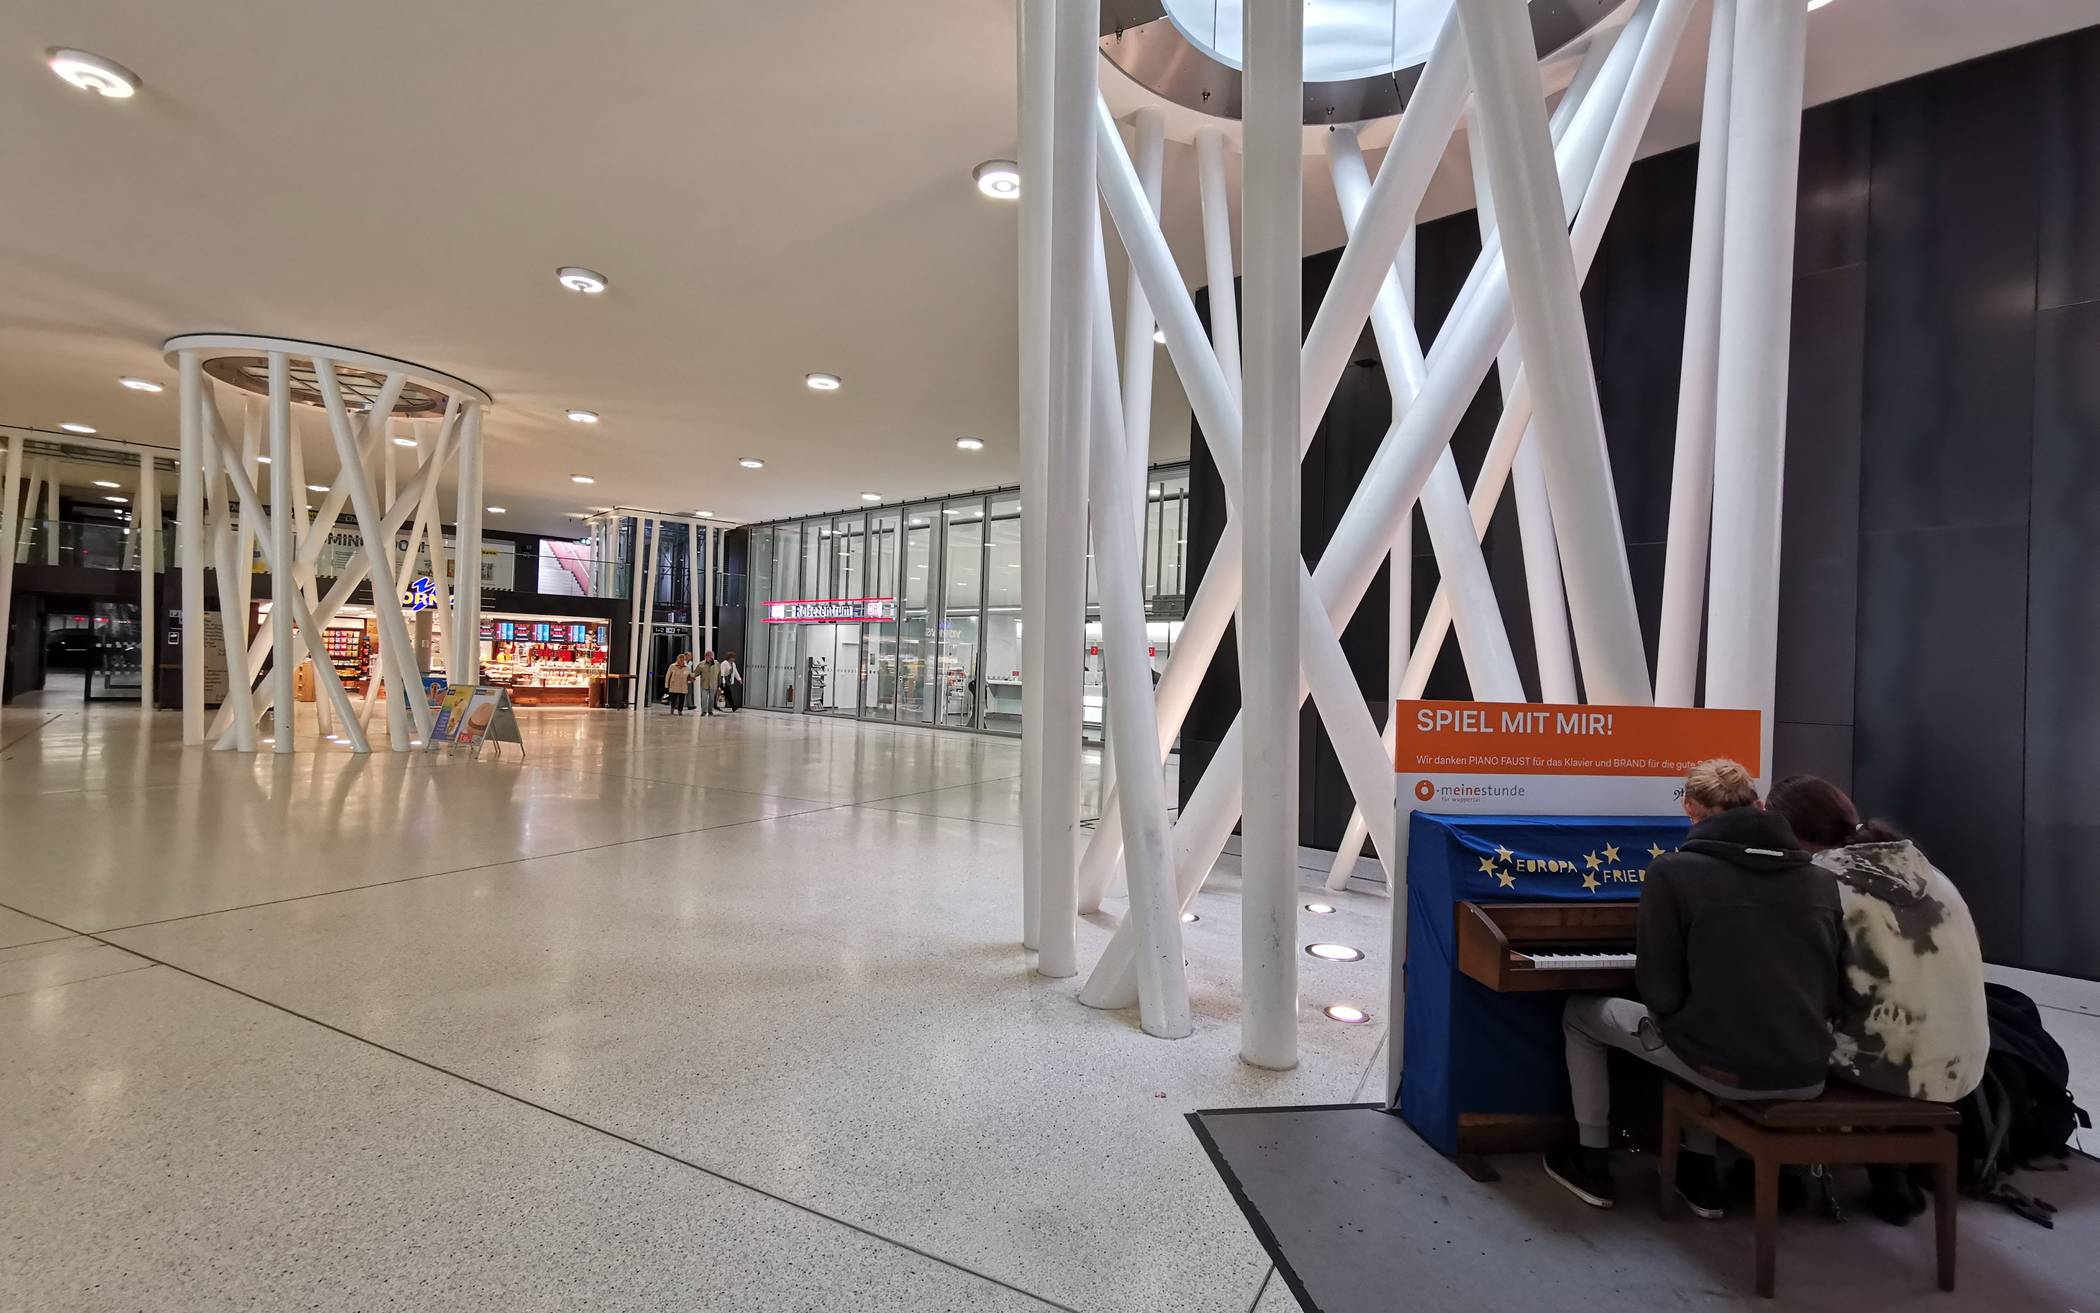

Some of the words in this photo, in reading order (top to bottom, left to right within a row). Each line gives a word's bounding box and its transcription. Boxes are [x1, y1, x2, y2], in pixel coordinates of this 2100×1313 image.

[795, 604, 852, 617] Reisezentrum
[1417, 708, 1494, 733] SPIEL
[1501, 711, 1550, 734] MIT
[1556, 712, 1613, 736] MIR!
[1416, 755, 1433, 764] Wir
[1434, 756, 1467, 765] danken
[1468, 756, 1499, 766] PIANO
[1501, 757, 1531, 766] FAUST
[1532, 757, 1545, 766] für
[1546, 758, 1562, 767] das
[1564, 758, 1593, 767] Klavier
[1595, 759, 1612, 768] und
[1613, 758, 1647, 768] BRAND
[1648, 759, 1660, 768] für
[1661, 760, 1675, 769] die
[1441, 783, 1526, 797] meinestunde
[1516, 859, 1578, 873] EUROPA
[1603, 869, 1646, 883] FRIED
